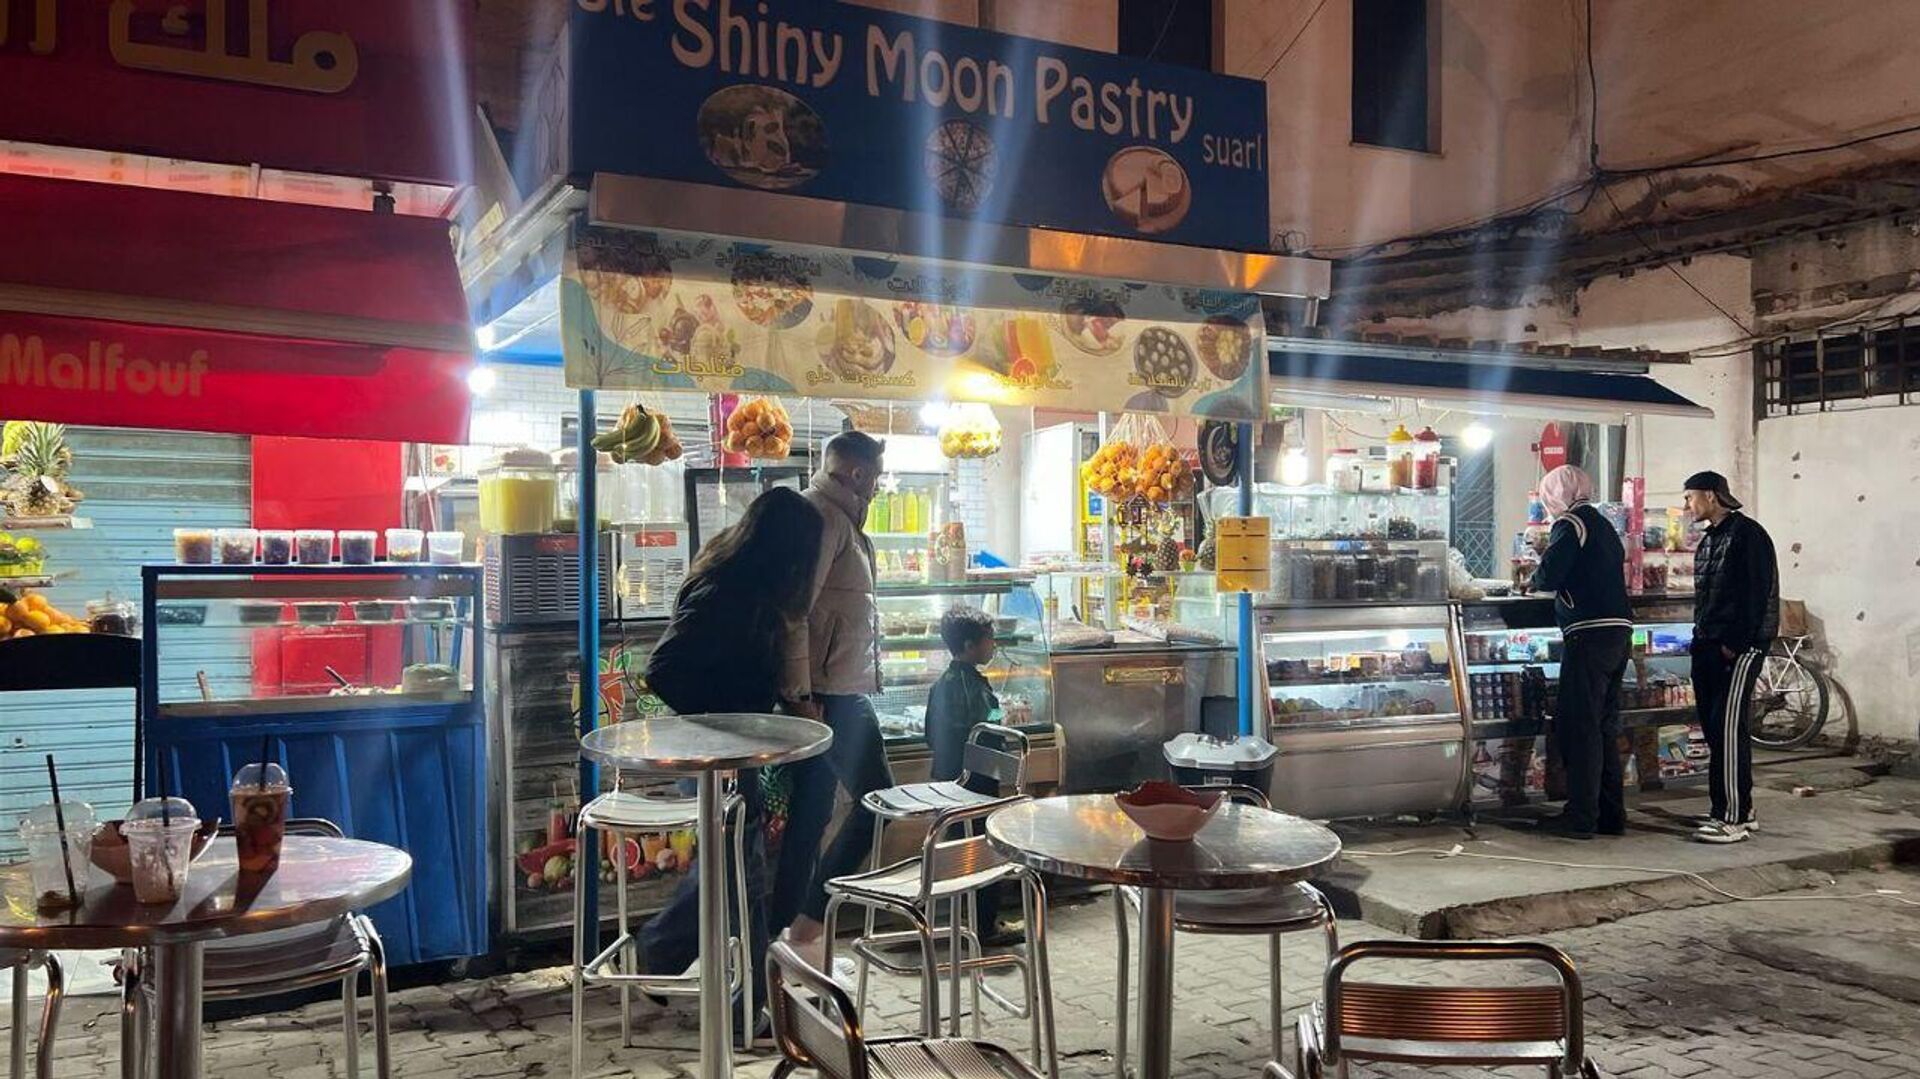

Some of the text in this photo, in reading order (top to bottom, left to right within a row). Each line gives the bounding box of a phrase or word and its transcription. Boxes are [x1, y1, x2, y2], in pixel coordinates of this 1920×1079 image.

[671, 0, 843, 88] Shiny
[866, 24, 1015, 119] Moon
[1035, 56, 1194, 144] Pastry
[1202, 132, 1263, 172] suarl
[0, 333, 209, 397] Malfouf
[651, 353, 745, 382] مثلجات
